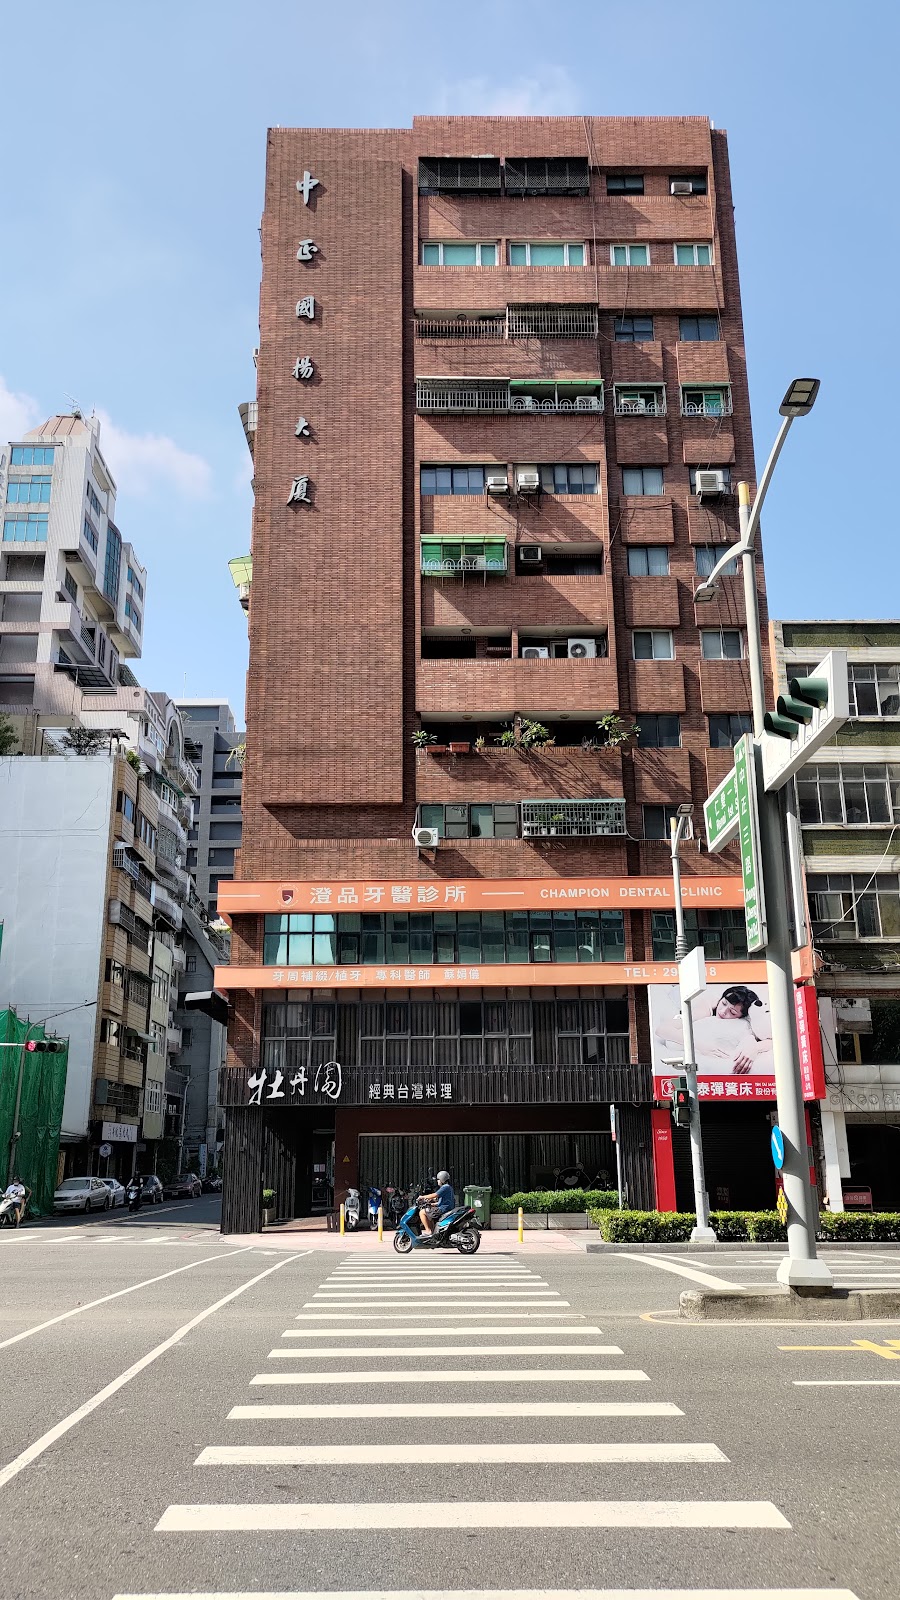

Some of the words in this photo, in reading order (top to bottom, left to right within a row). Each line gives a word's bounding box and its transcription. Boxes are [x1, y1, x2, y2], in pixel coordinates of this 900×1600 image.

[739, 768, 752, 876] 中正三路
[309, 885, 467, 905] 澄品牙醫診所
[540, 888, 610, 899] CHAMPION
[619, 887, 671, 898] DENTAL
[679, 886, 723, 897] CLINIC
[272, 969, 362, 982] 牙周補綴/植牙
[375, 969, 431, 981] 專科醫師
[248, 1061, 342, 1105] 牡丹園
[368, 1083, 453, 1100] 經典台灣料理
